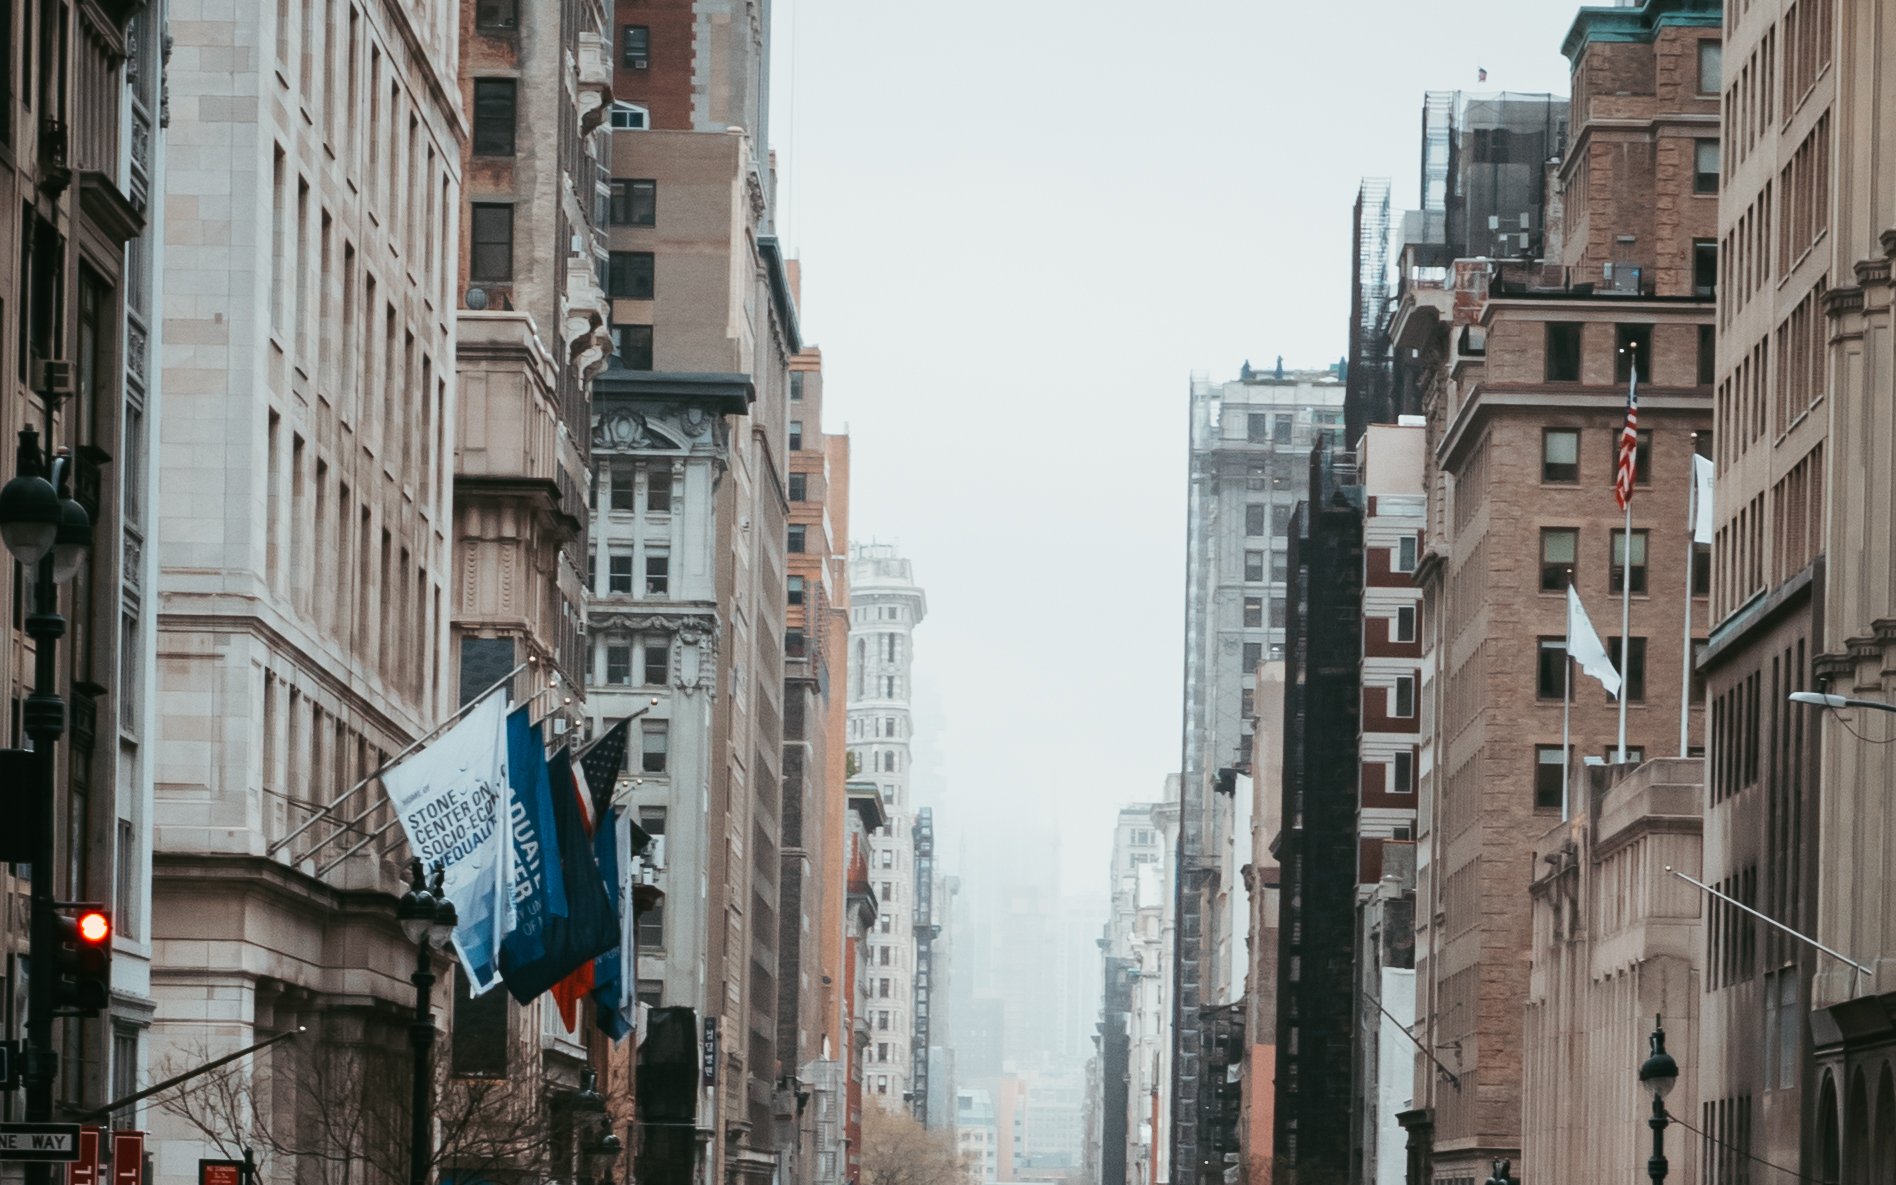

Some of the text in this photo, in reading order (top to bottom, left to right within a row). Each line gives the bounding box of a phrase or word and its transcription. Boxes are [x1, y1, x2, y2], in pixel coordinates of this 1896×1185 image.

[408, 789, 459, 830] STONE
[415, 781, 491, 845] CENTER ON
[0, 1135, 66, 1149] NE WAY
